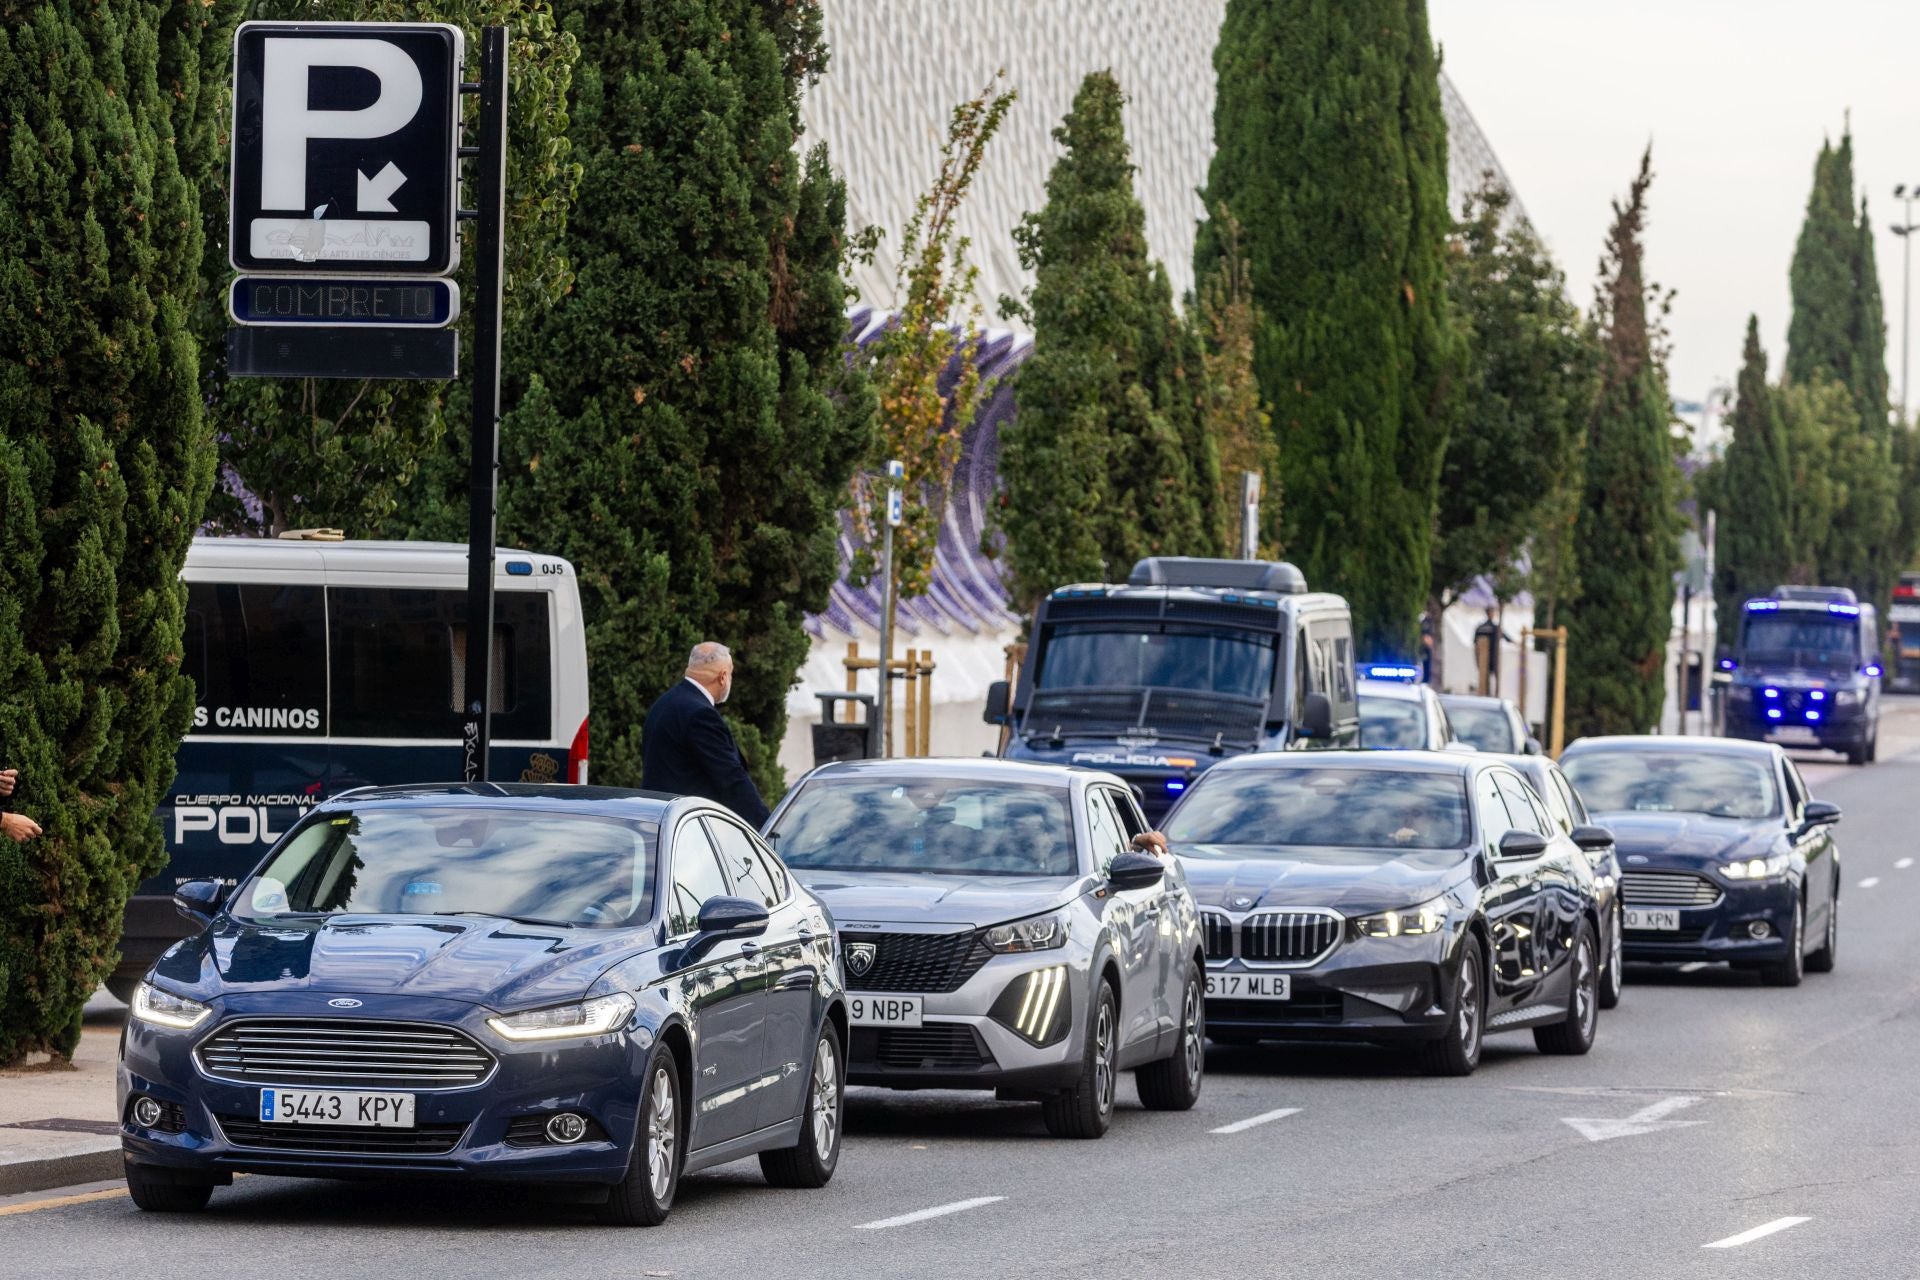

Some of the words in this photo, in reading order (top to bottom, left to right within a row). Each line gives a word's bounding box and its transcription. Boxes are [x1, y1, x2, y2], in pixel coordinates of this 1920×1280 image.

[261, 38, 423, 210] P
[542, 564, 563, 575] 0J5
[215, 707, 320, 729] CANINOS
[175, 795, 241, 805] CUERPO
[246, 795, 321, 805] NACIONAL
[1646, 912, 1673, 926] KPN
[1247, 977, 1284, 996] MLB
[872, 1000, 914, 1021] NBP
[264, 1108, 271, 1116] E
[281, 1094, 342, 1120] 5443
[358, 1096, 403, 1123] KPY
